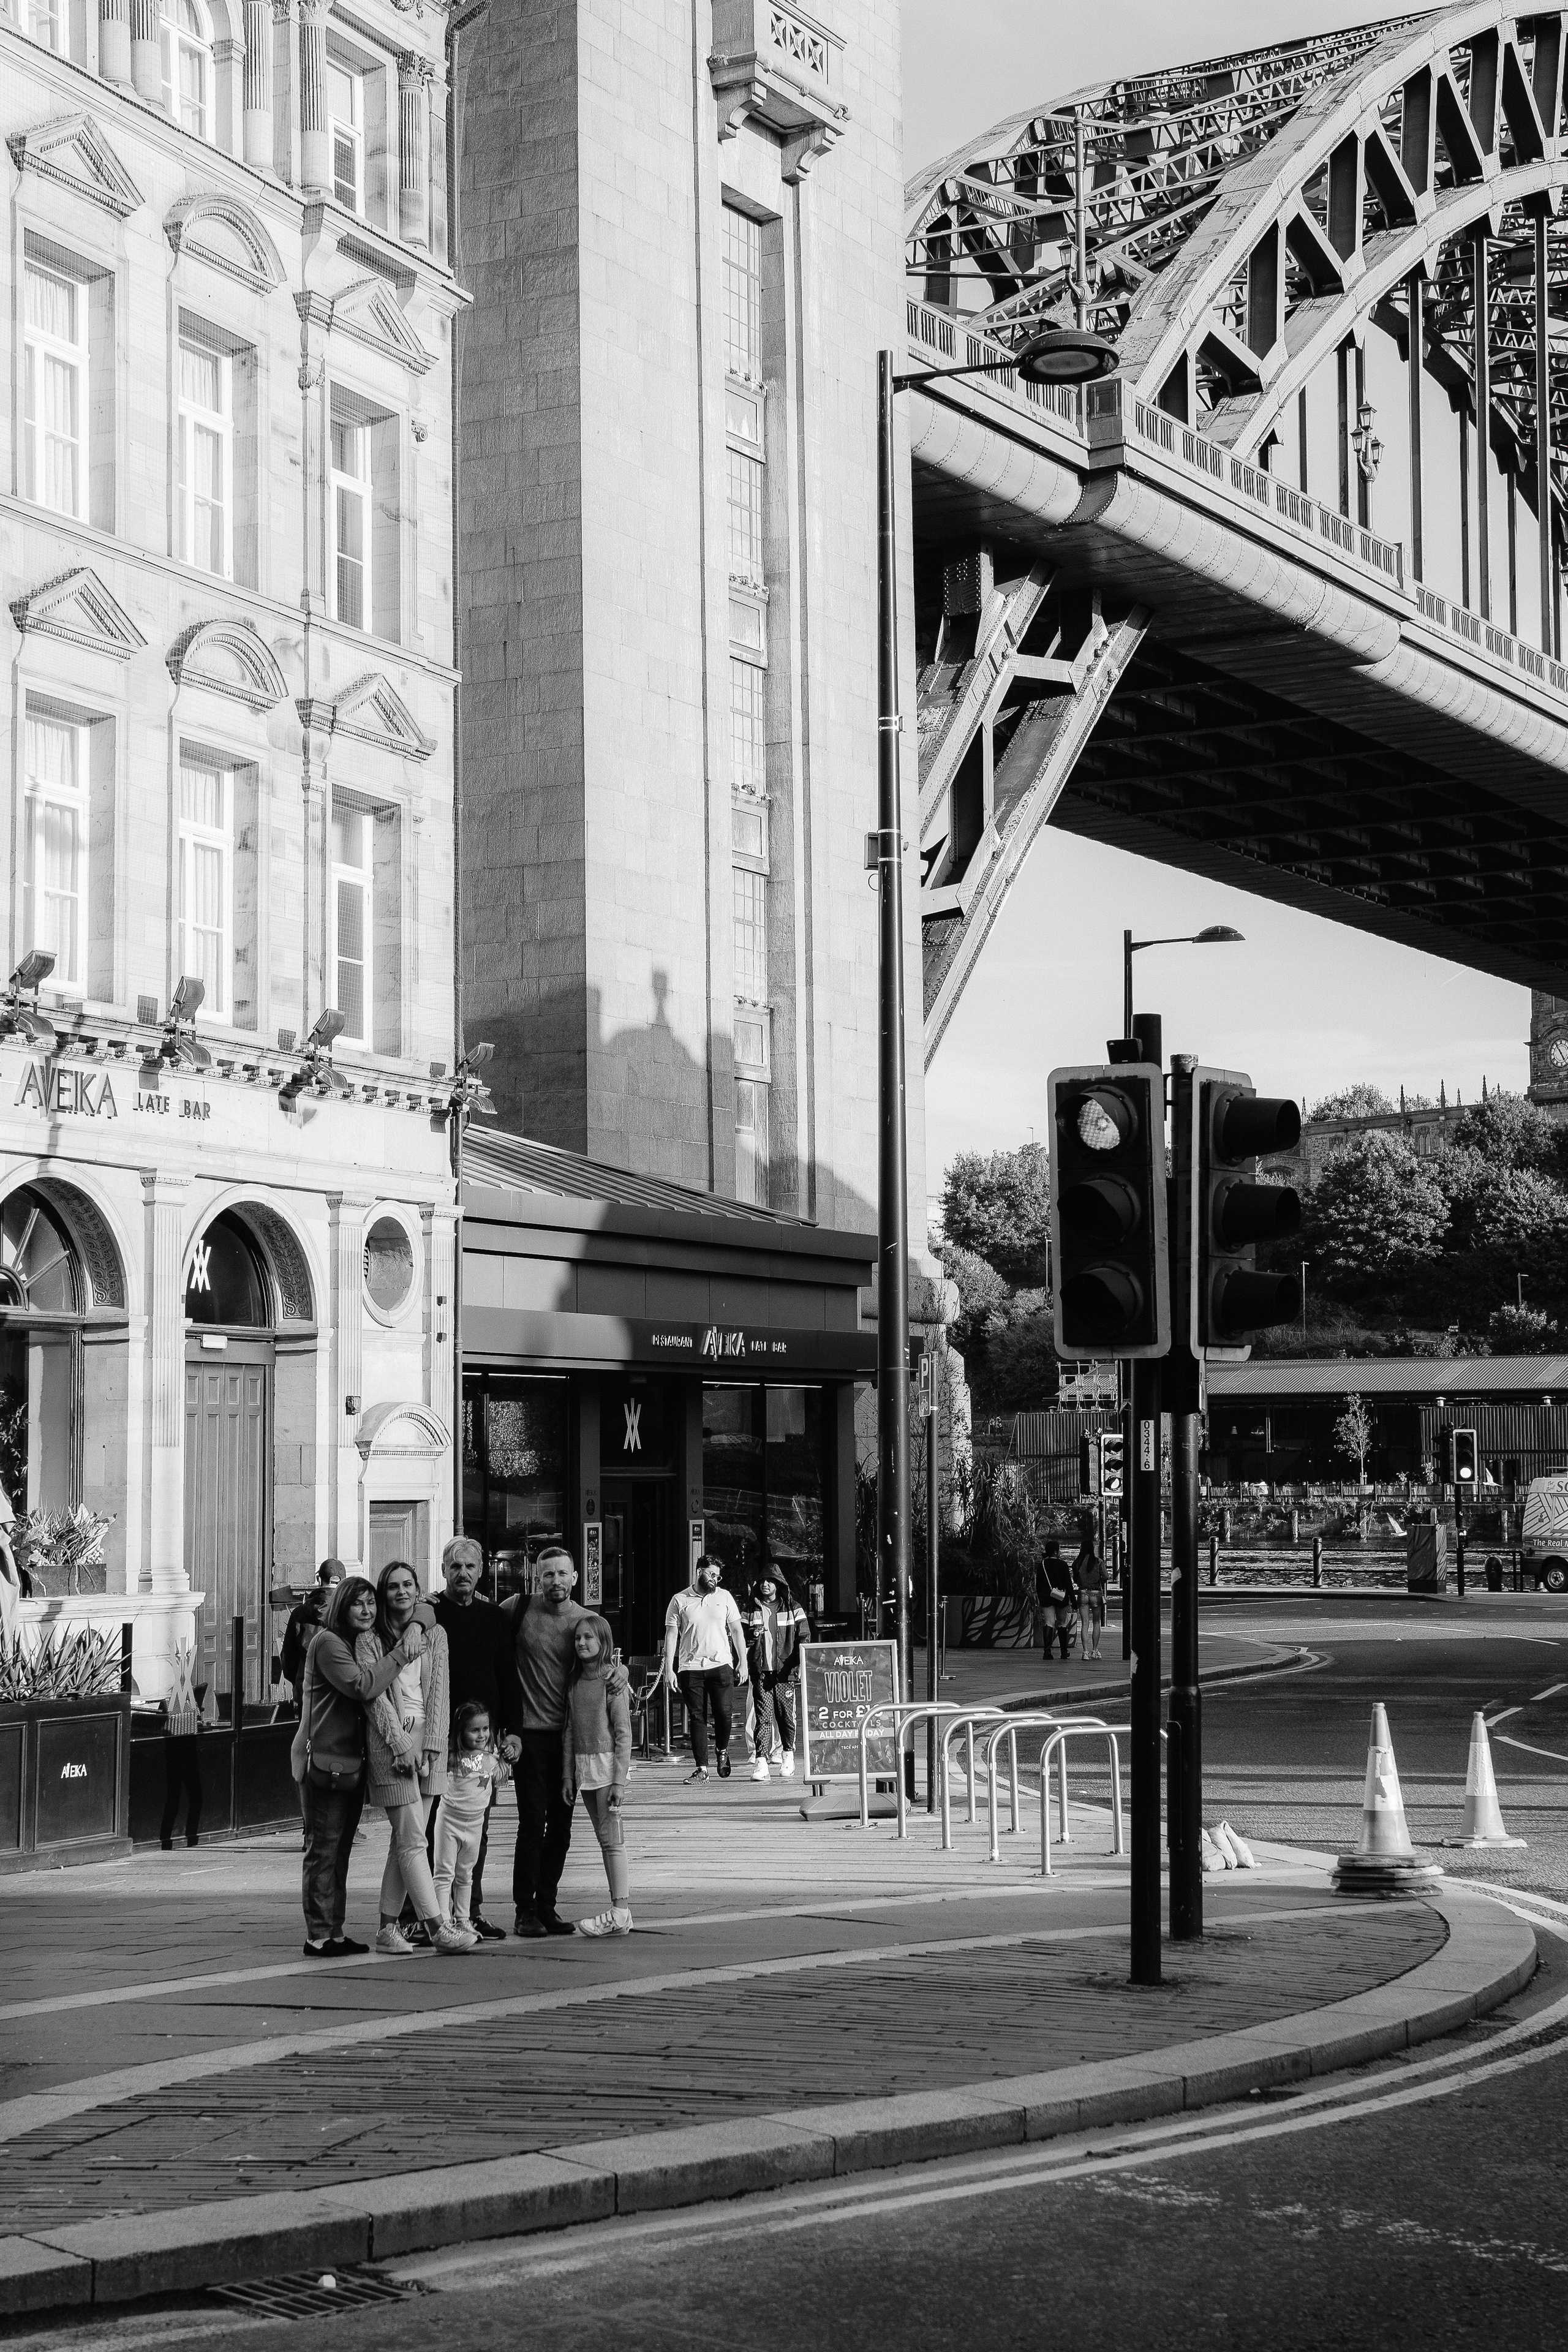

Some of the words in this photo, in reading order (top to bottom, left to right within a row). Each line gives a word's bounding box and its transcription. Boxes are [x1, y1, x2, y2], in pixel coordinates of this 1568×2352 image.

[15, 1056, 118, 1118] AVEIKA
[133, 1092, 170, 1114] LATE
[179, 1099, 211, 1120] BAR
[701, 1326, 745, 1361] AVEIKA
[772, 1341, 786, 1353] BAR
[921, 1358, 929, 1388] P
[834, 1654, 864, 1667] AVEIKA
[824, 1670, 873, 1703] VIOLET
[818, 1706, 829, 1719] 2
[833, 1710, 853, 1719] FOR
[822, 1719, 881, 1728] COCKTLS
[61, 1763, 87, 1779] AVEIKA
